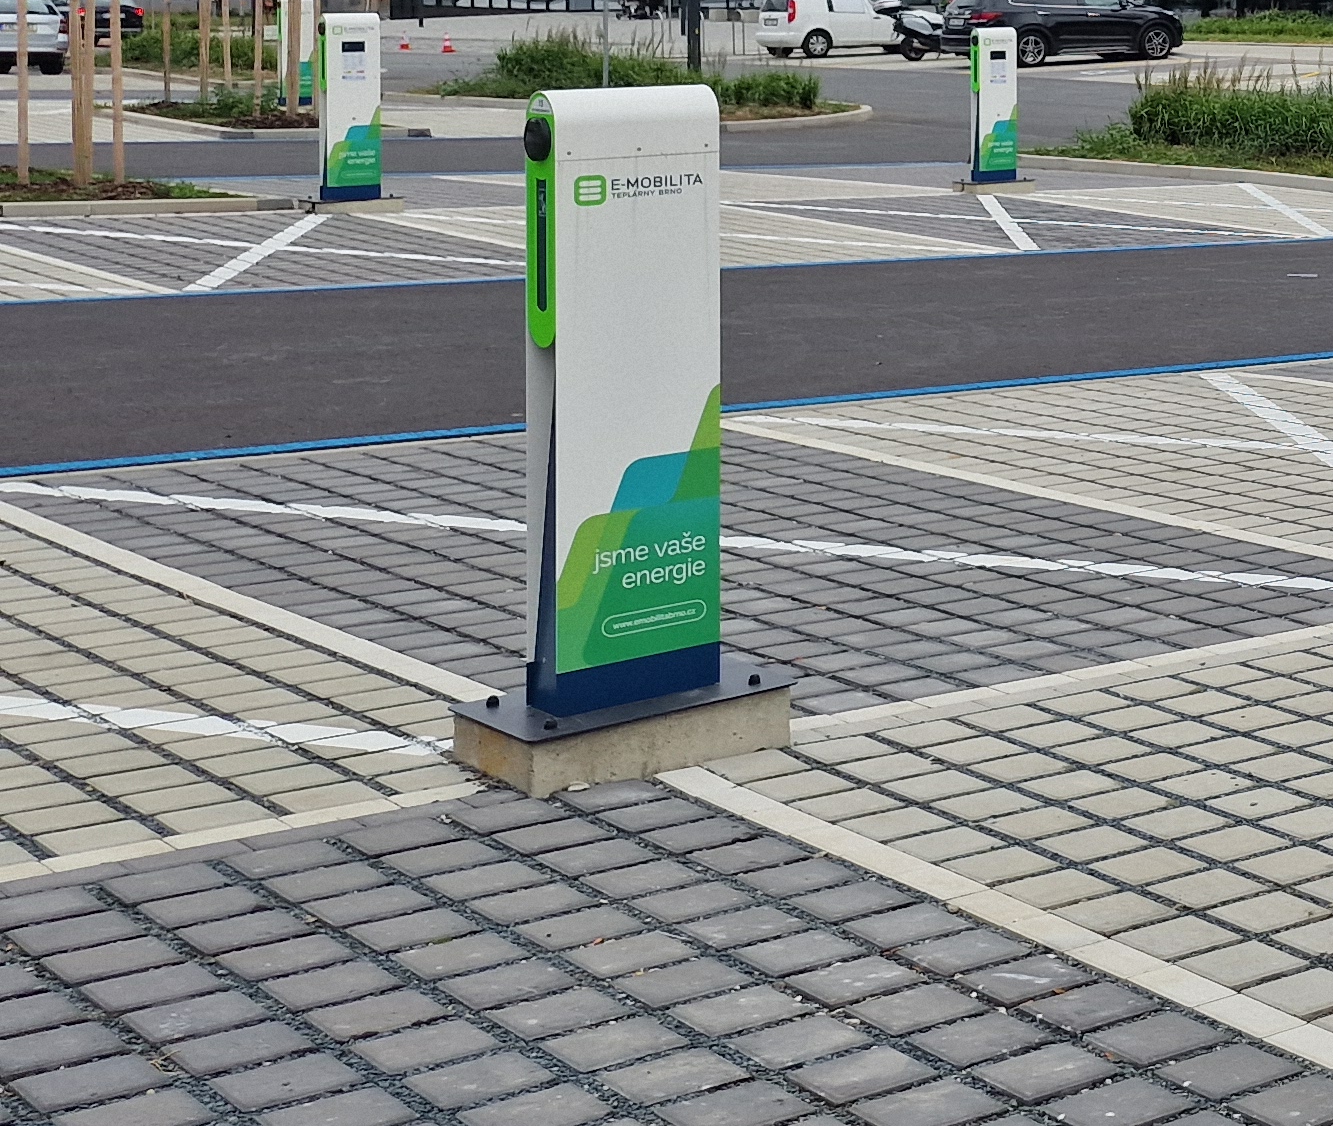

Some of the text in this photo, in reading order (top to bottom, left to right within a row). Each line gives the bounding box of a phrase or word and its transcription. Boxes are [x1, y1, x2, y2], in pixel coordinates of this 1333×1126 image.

[610, 173, 703, 191] E-MOBILITA
[611, 187, 683, 200] TEPLÁRNY BRNO
[592, 530, 706, 575] jsme vaše
[622, 557, 706, 589] energie
